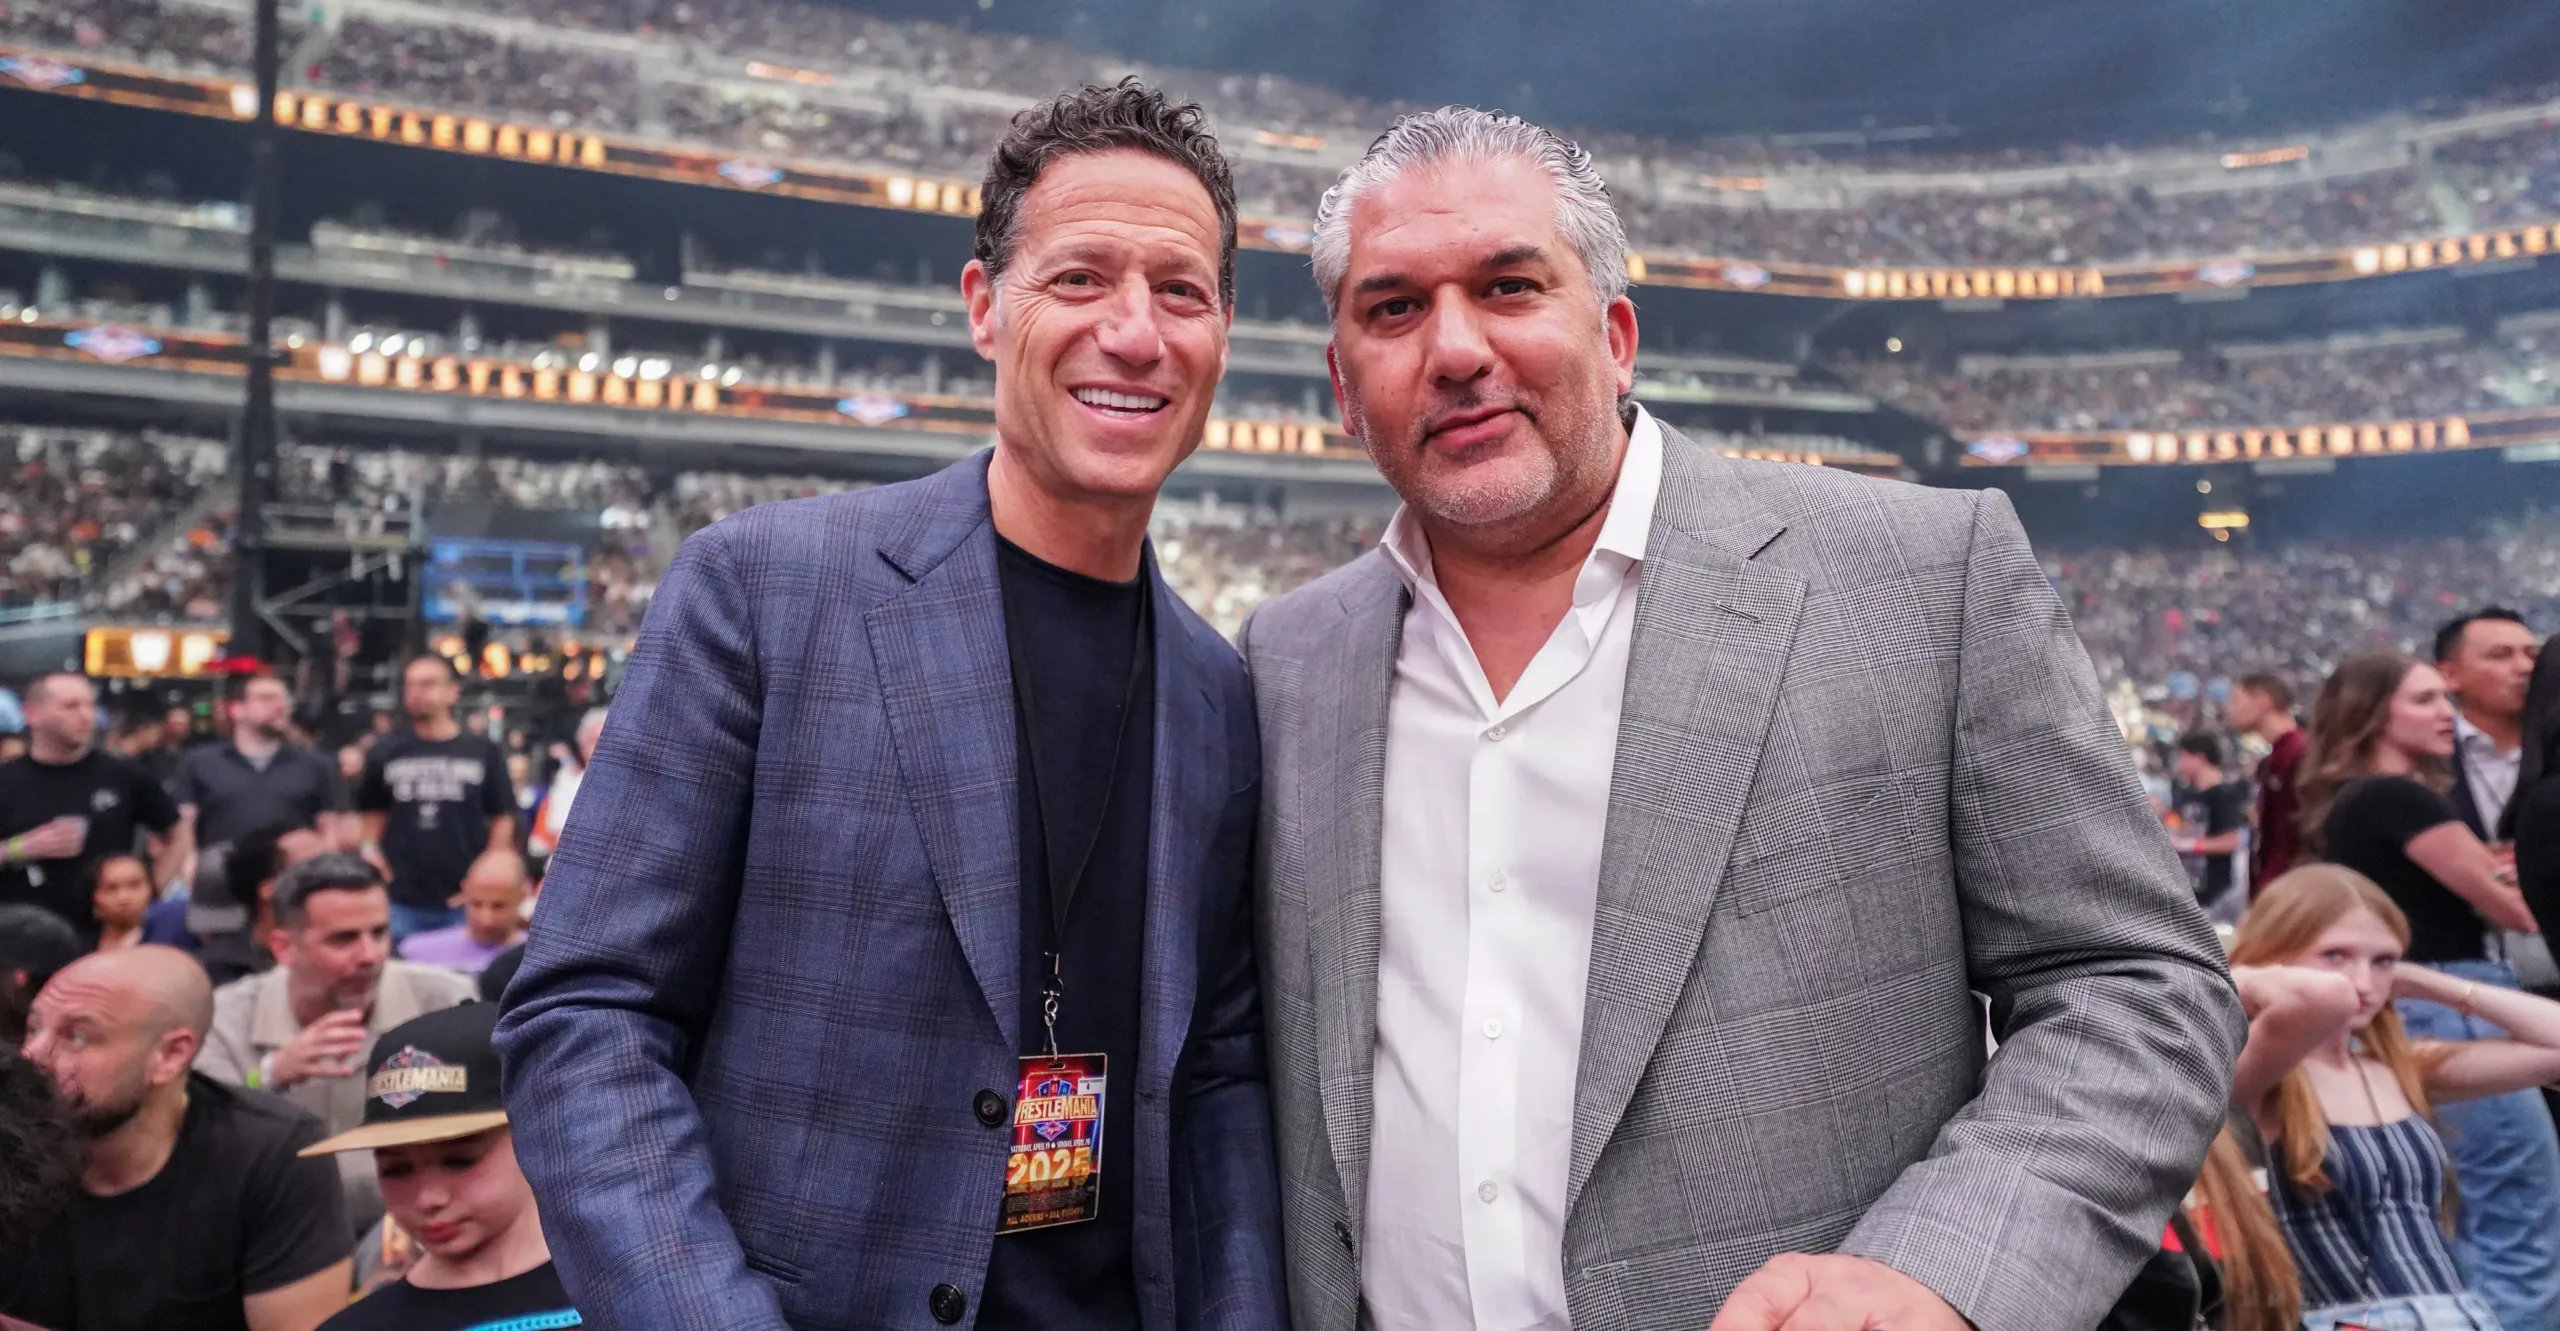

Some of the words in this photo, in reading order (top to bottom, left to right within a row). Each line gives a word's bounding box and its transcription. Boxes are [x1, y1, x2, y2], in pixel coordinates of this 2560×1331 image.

[2353, 221, 2560, 275] ESTLE
[366, 1066, 466, 1098] STLEMANIA
[1007, 1147, 1091, 1194] 2025
